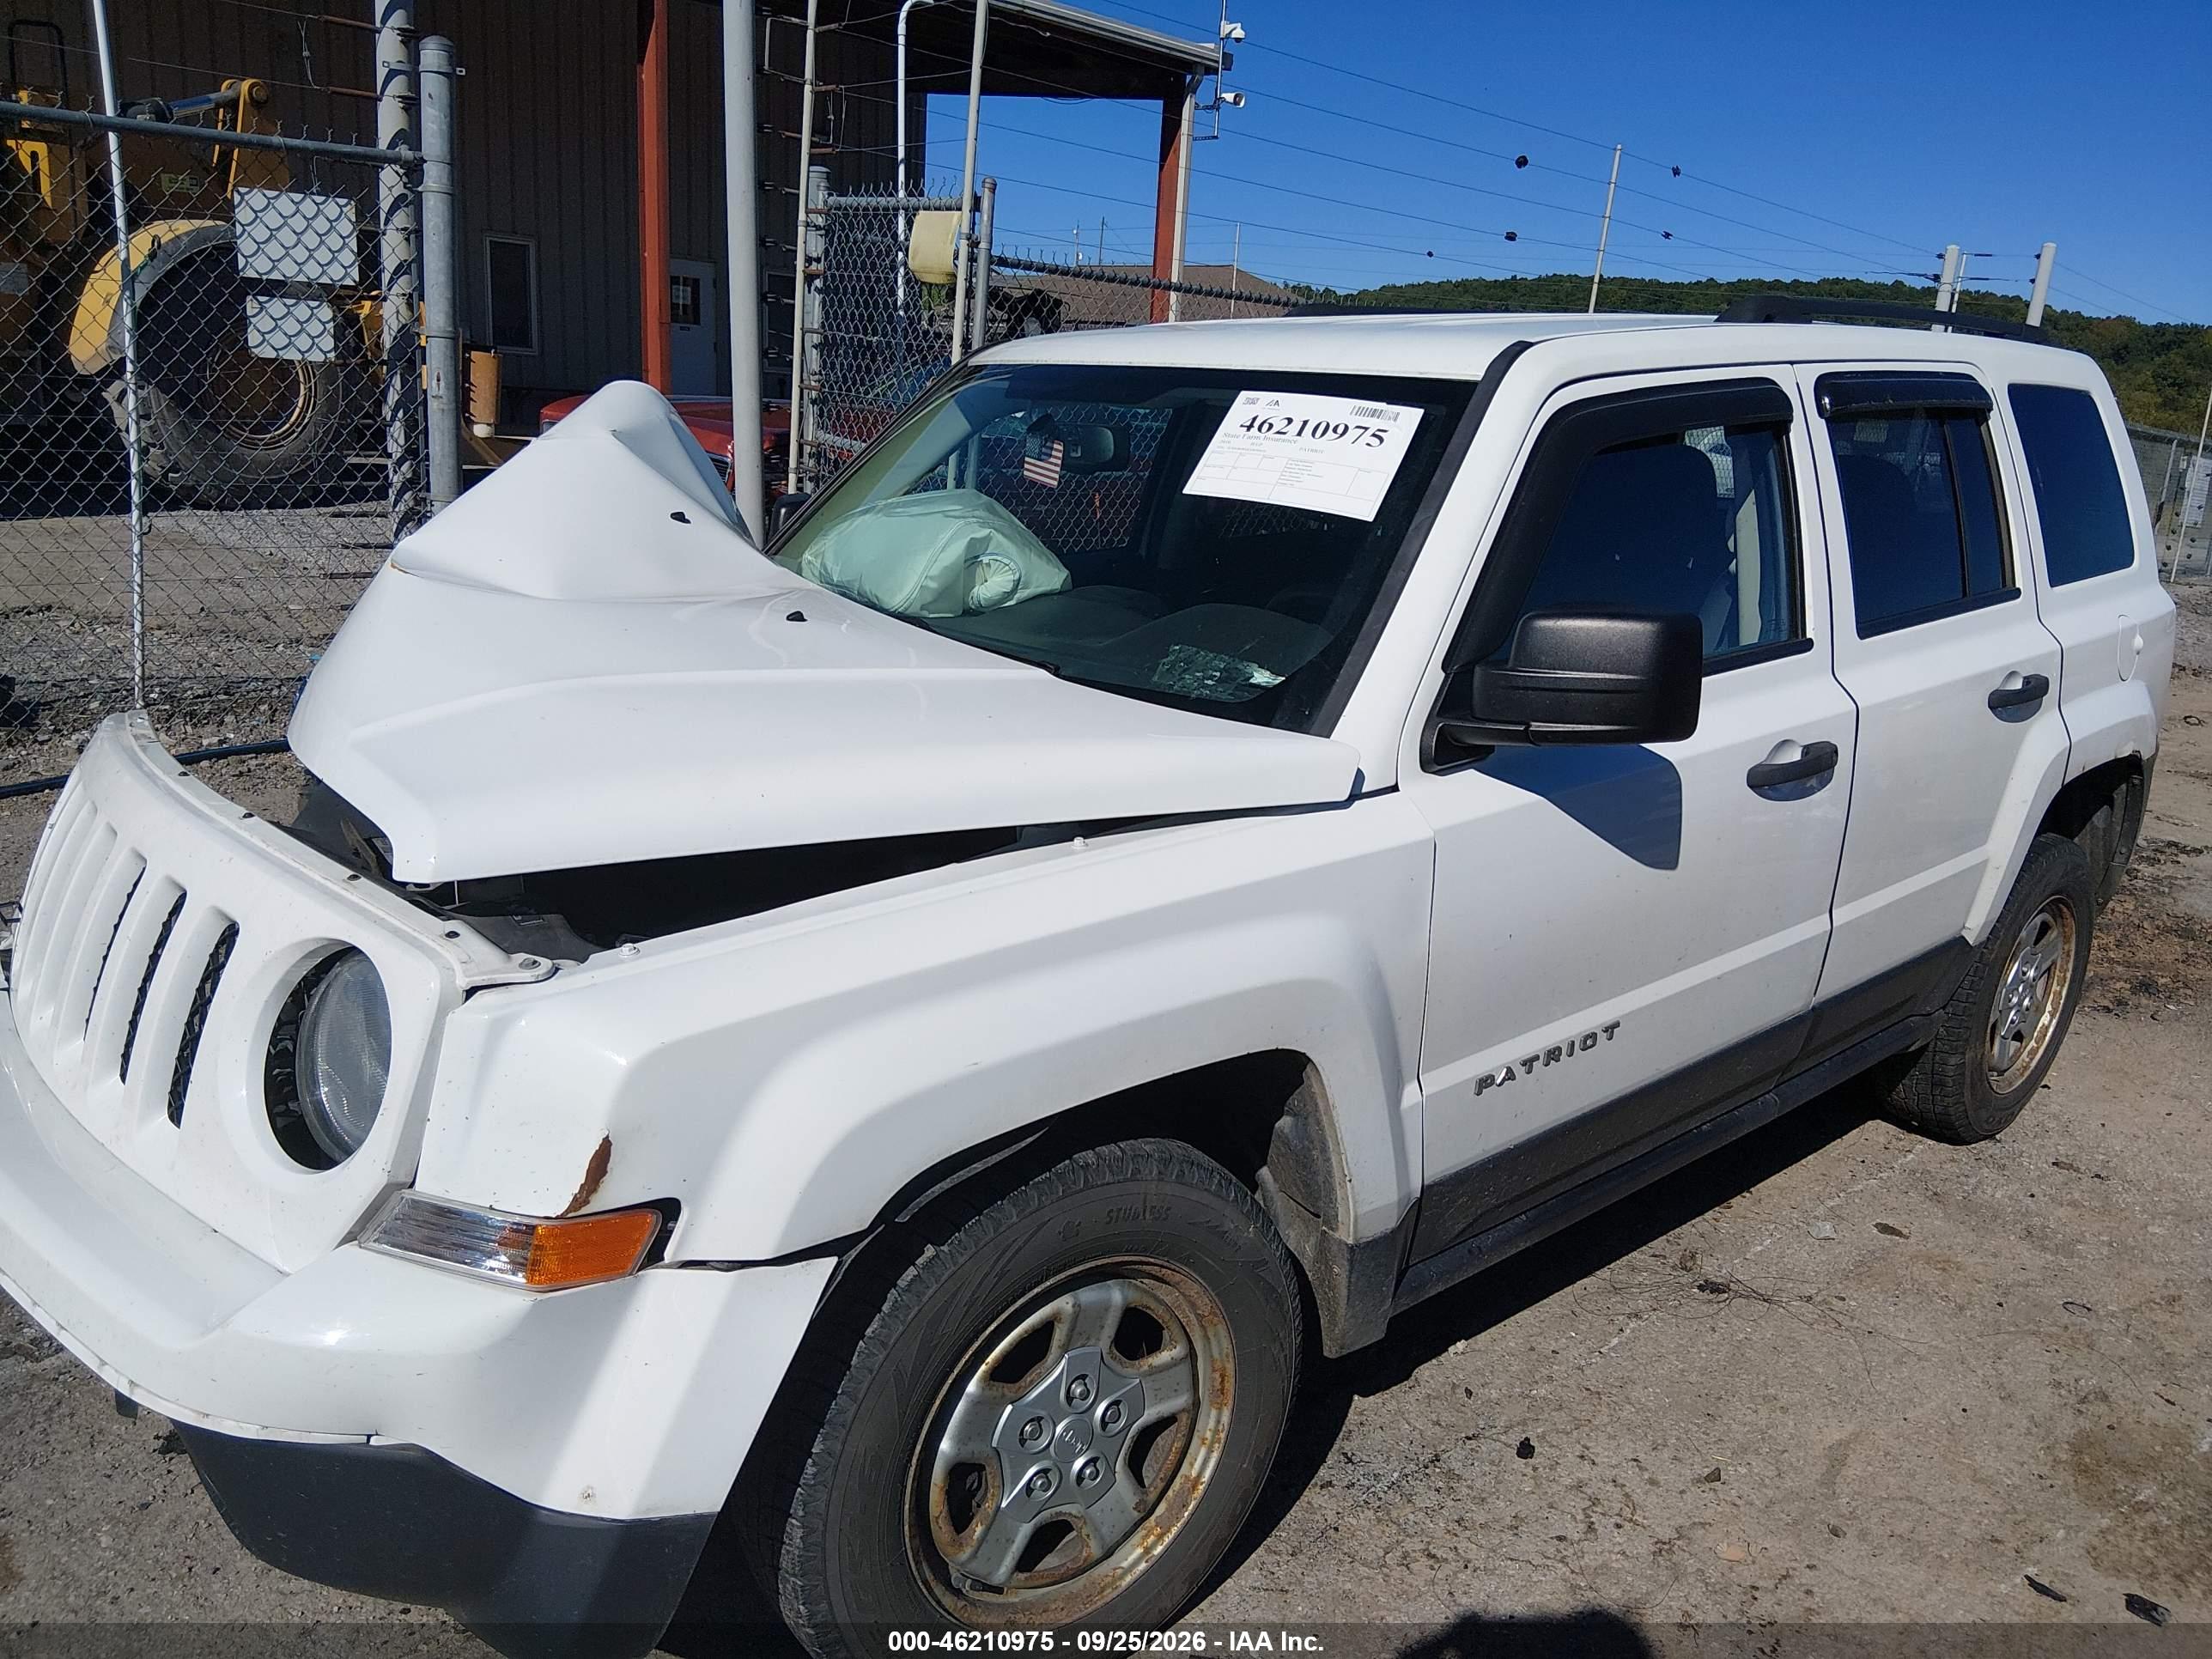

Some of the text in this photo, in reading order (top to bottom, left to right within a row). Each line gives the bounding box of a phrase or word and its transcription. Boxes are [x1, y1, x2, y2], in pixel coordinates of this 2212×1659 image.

[1239, 414, 1389, 448] 46210975
[1262, 434, 1298, 446] Insurance
[1473, 1019, 1621, 1097] PATRIOT
[1105, 1204, 1172, 1225] STUDLESS
